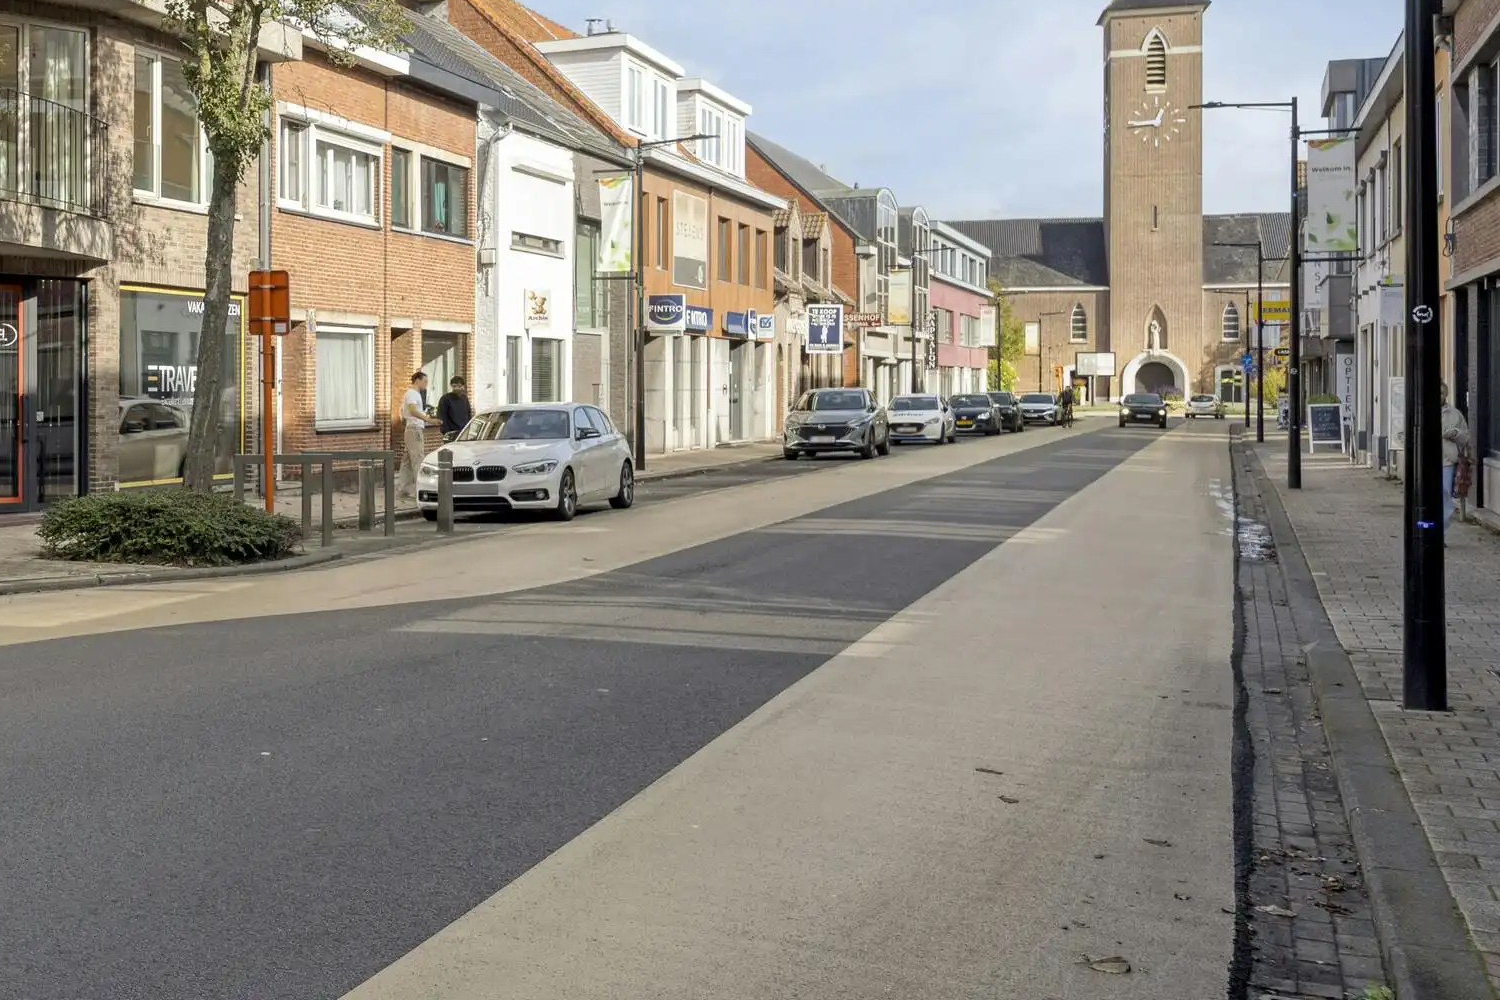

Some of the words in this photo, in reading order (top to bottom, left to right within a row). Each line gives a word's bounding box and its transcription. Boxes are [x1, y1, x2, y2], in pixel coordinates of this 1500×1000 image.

[649, 305, 682, 313] FINTRO
[147, 364, 198, 392] ETRAVE
[1344, 357, 1353, 412] OPTIEK
